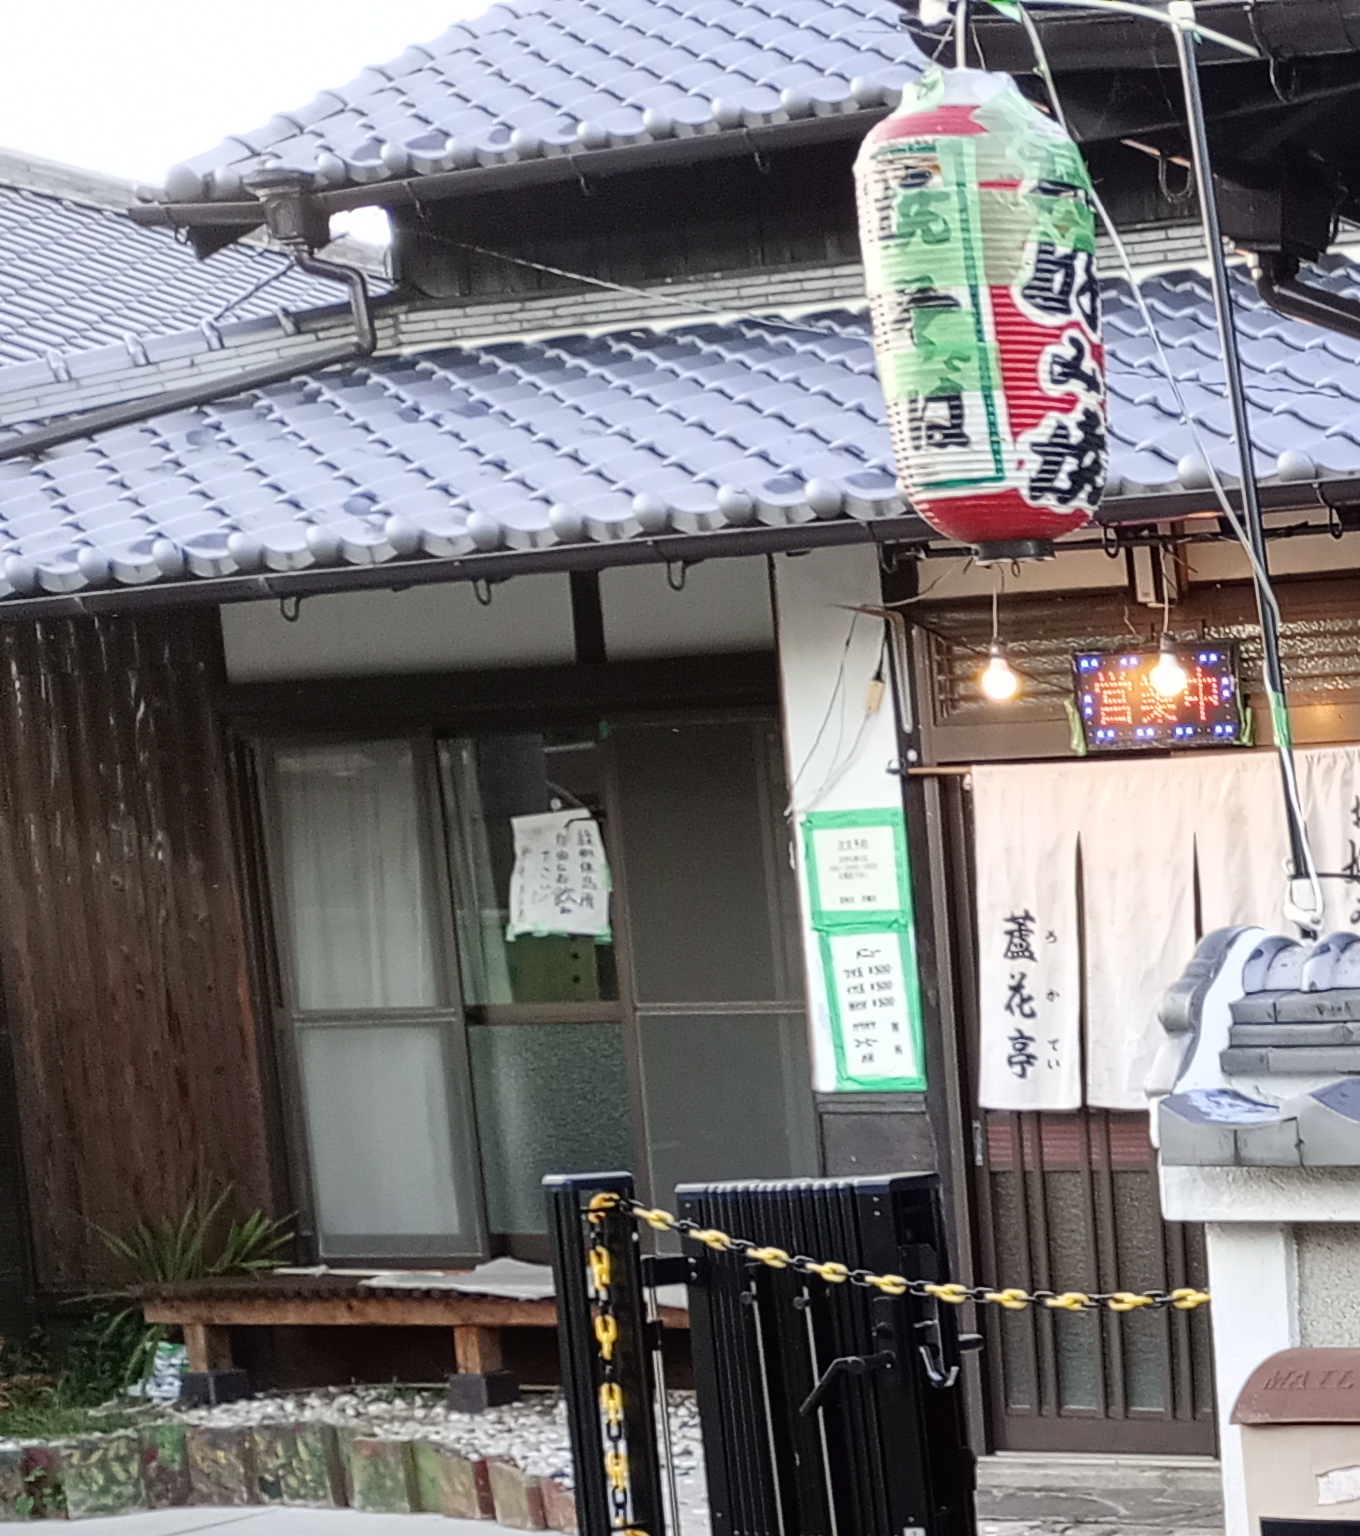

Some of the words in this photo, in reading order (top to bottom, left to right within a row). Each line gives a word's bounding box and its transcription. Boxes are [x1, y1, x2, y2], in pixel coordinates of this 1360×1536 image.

[1003, 909, 1038, 1080] 蘆花亭
[1045, 929, 1061, 1070] ろかてい
[1263, 1369, 1354, 1391] MAIL
